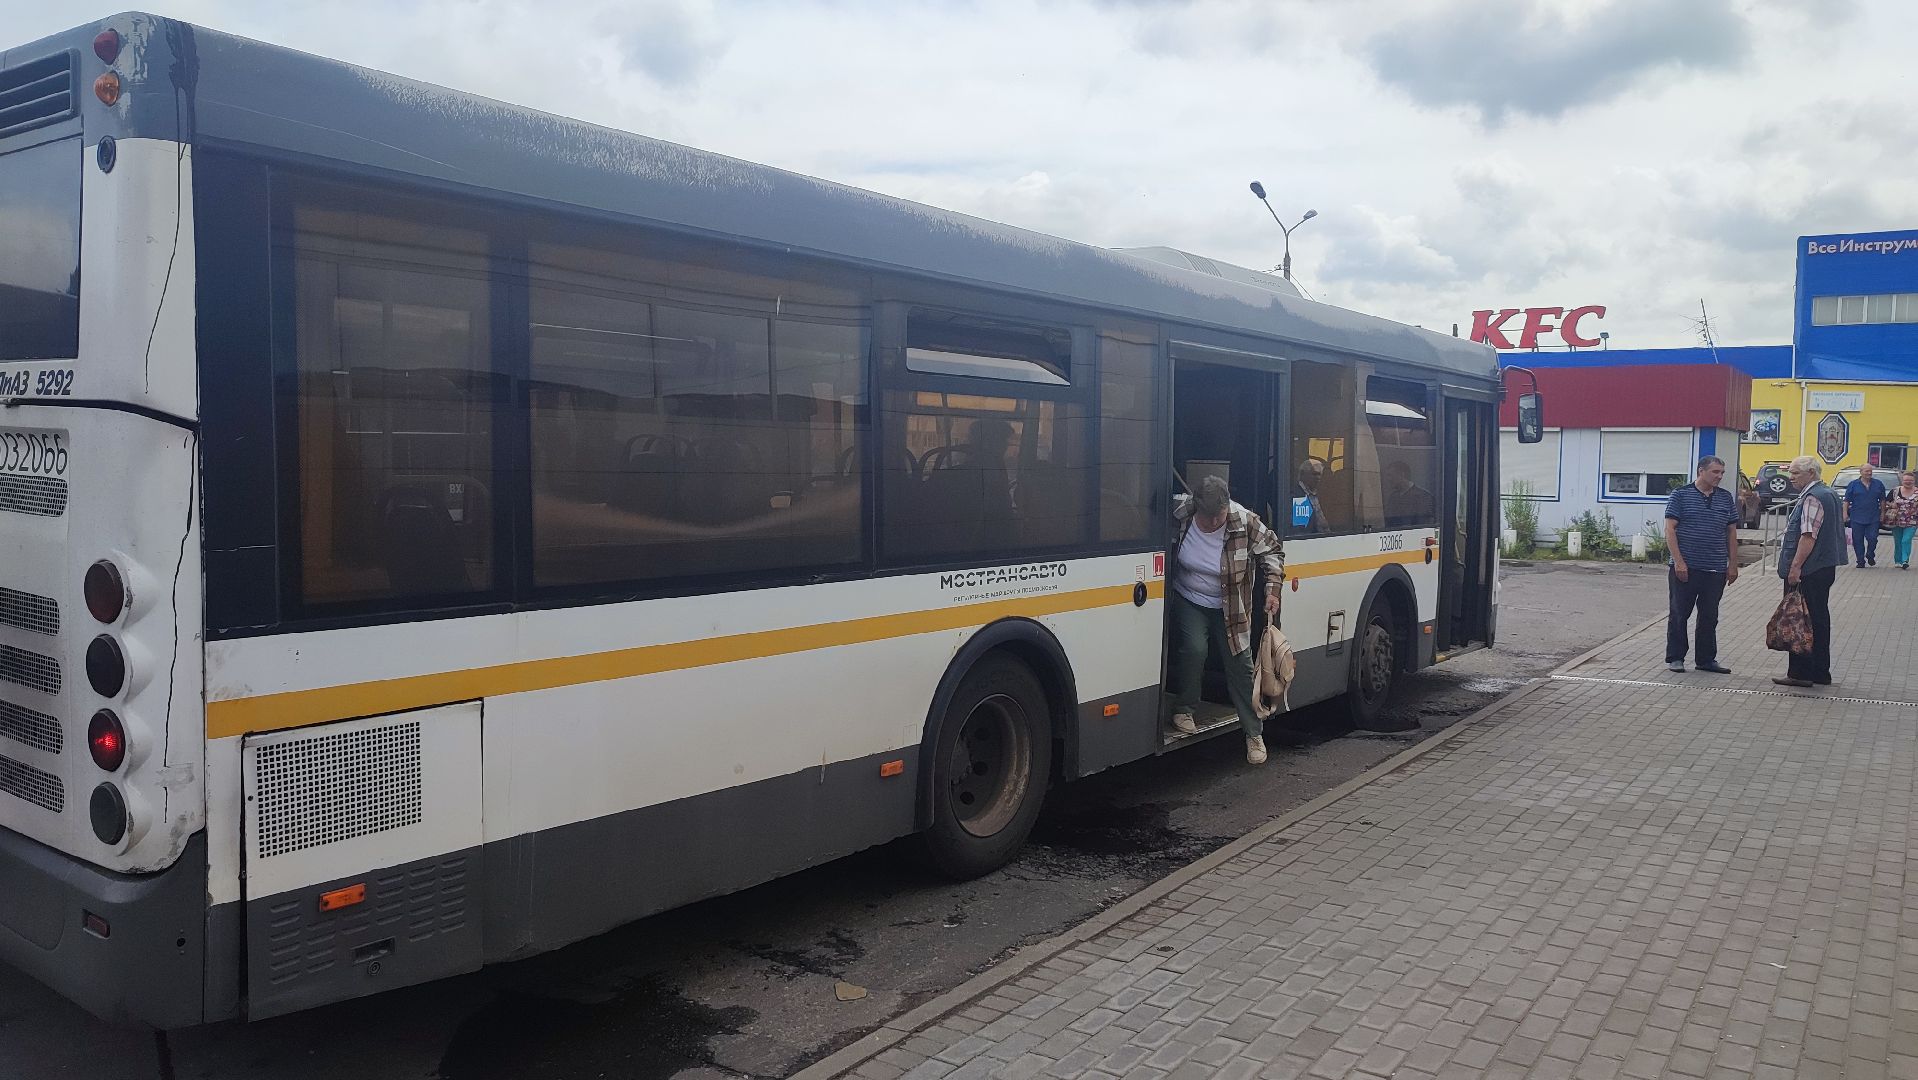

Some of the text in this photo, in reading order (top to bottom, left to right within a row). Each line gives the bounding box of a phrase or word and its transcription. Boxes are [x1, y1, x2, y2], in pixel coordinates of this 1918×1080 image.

[1808, 241, 1837, 255] Все
[1470, 305, 1606, 349] KFC
[36, 369, 74, 396] 5292
[940, 563, 1067, 590] МОСТРАНСАВТО
